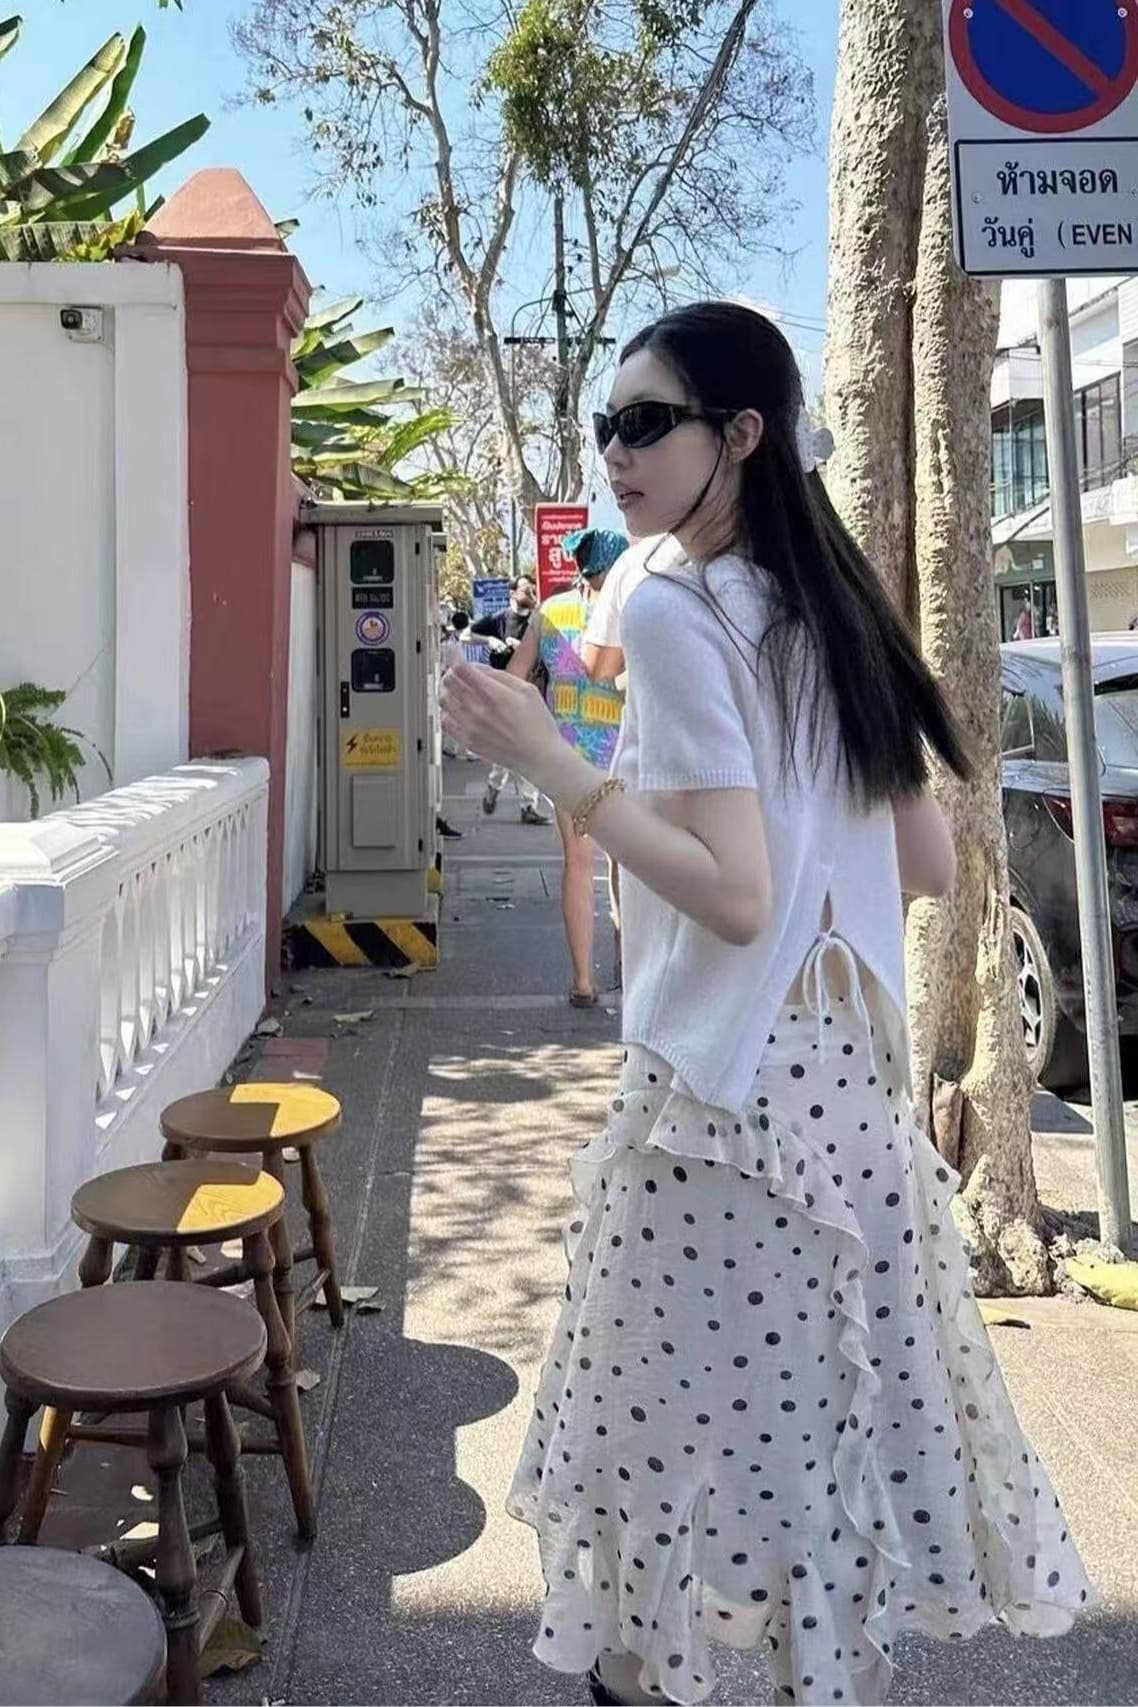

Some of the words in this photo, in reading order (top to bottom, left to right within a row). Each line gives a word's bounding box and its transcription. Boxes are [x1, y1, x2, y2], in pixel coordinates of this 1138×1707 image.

[997, 161, 1118, 195] ห้ามจอด
[982, 216, 1035, 258] วันคู่
